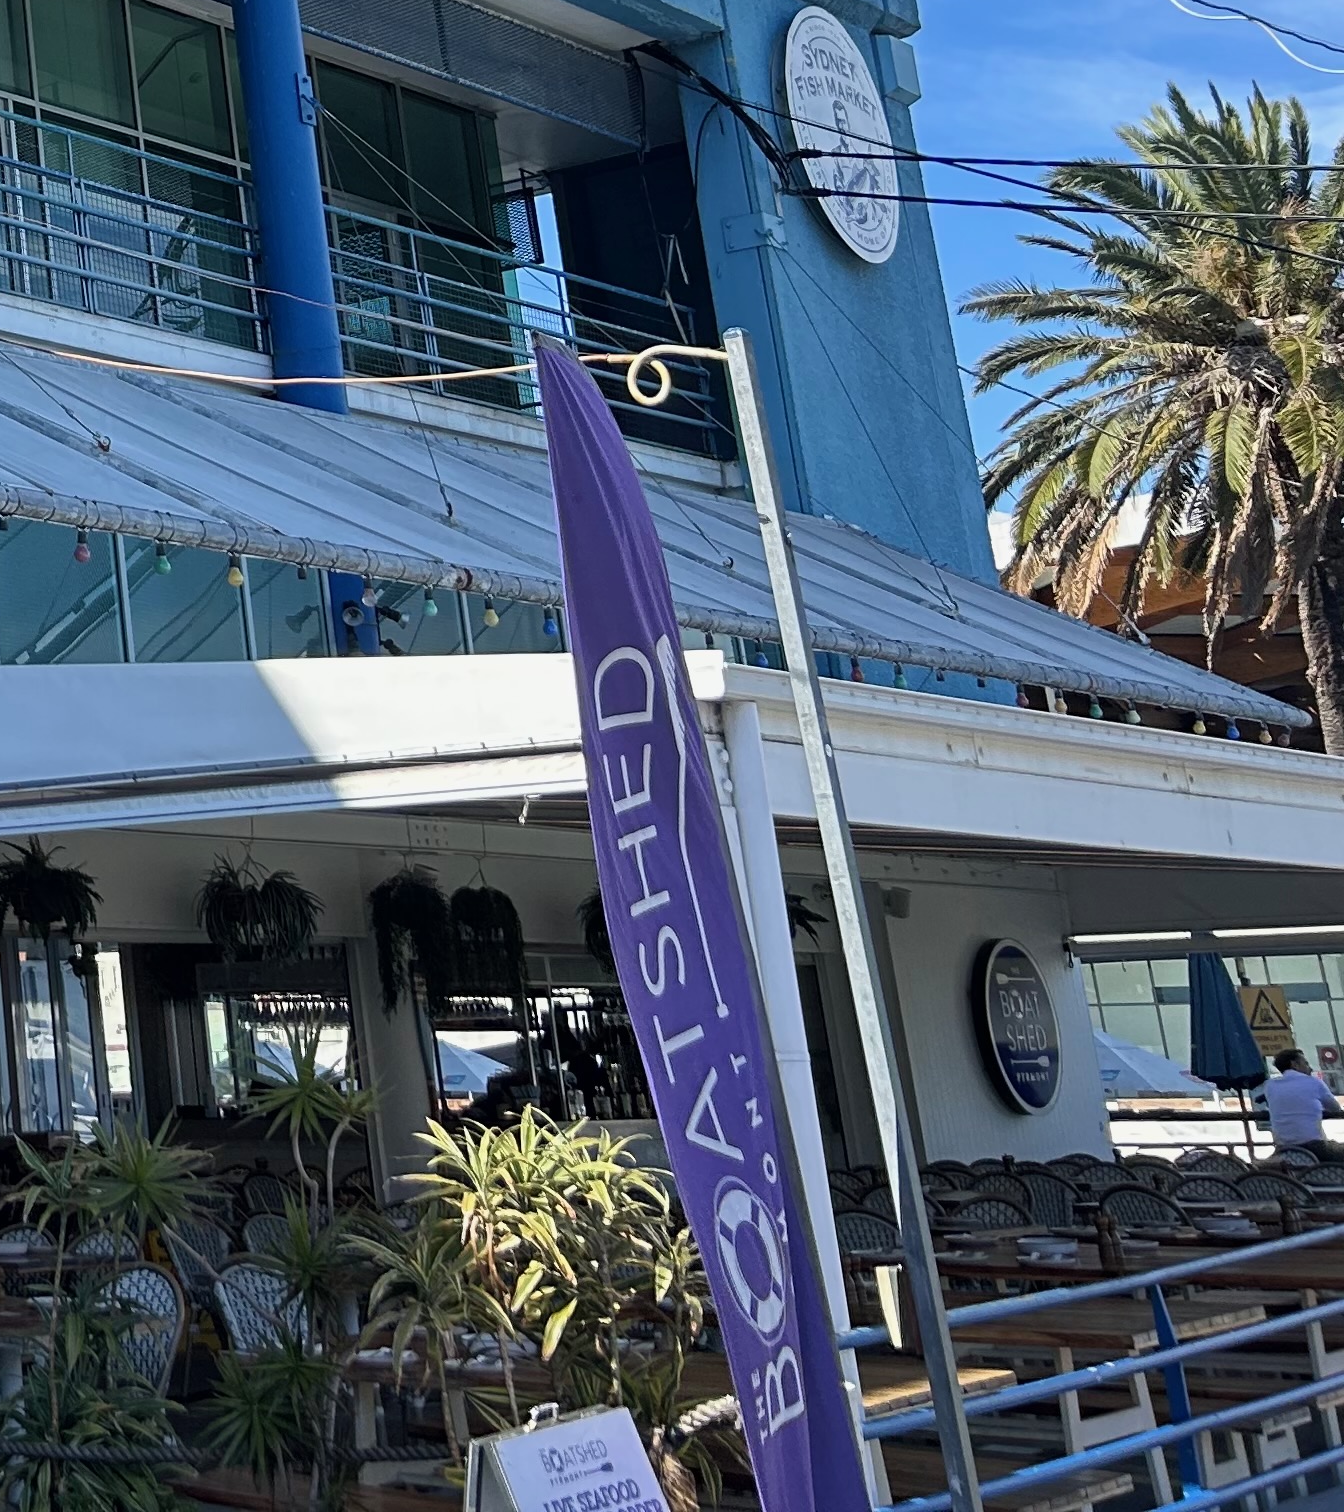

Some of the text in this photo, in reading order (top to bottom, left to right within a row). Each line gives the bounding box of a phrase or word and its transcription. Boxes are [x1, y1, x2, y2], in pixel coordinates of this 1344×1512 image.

[800, 43, 856, 83] SYDNEY
[794, 75, 878, 122] FISH MARKET
[999, 989, 1041, 1020] BOAT
[593, 645, 806, 1438] BOATSHED
[1006, 1023, 1047, 1052] SHED
[750, 1368, 772, 1446] THE
[541, 1440, 608, 1472] BOATSHED
[575, 1477, 641, 1512] SEAFOOD
[618, 1498, 664, 1512] DER
